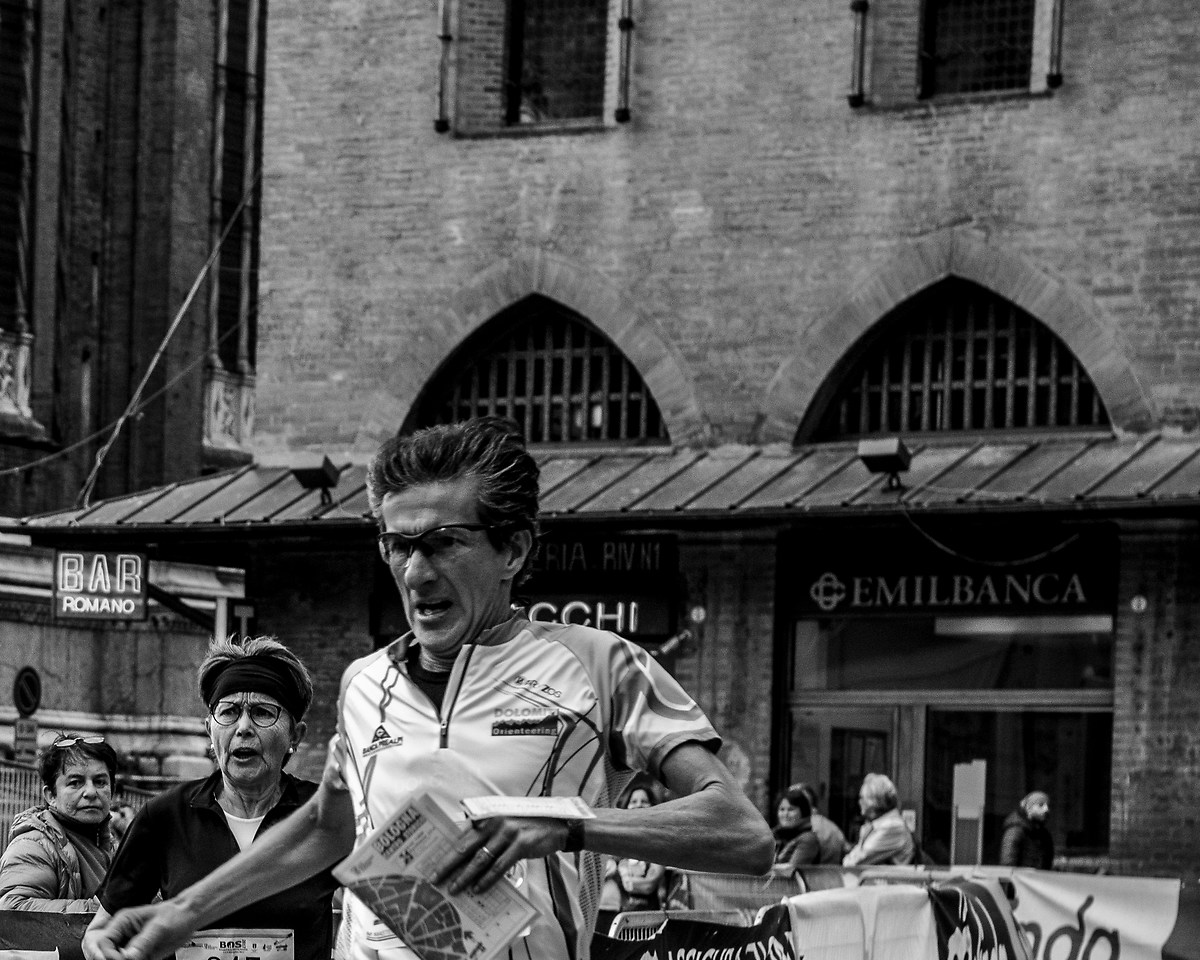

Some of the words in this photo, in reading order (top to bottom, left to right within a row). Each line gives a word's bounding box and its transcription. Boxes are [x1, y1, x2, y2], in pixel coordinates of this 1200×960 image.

[534, 541, 587, 571] RIA
[58, 553, 142, 594] BAR
[852, 572, 1087, 606] EMILBANCA
[62, 596, 135, 614] ROMANO
[524, 601, 639, 633] CCHI
[492, 727, 558, 736] Orienteering
